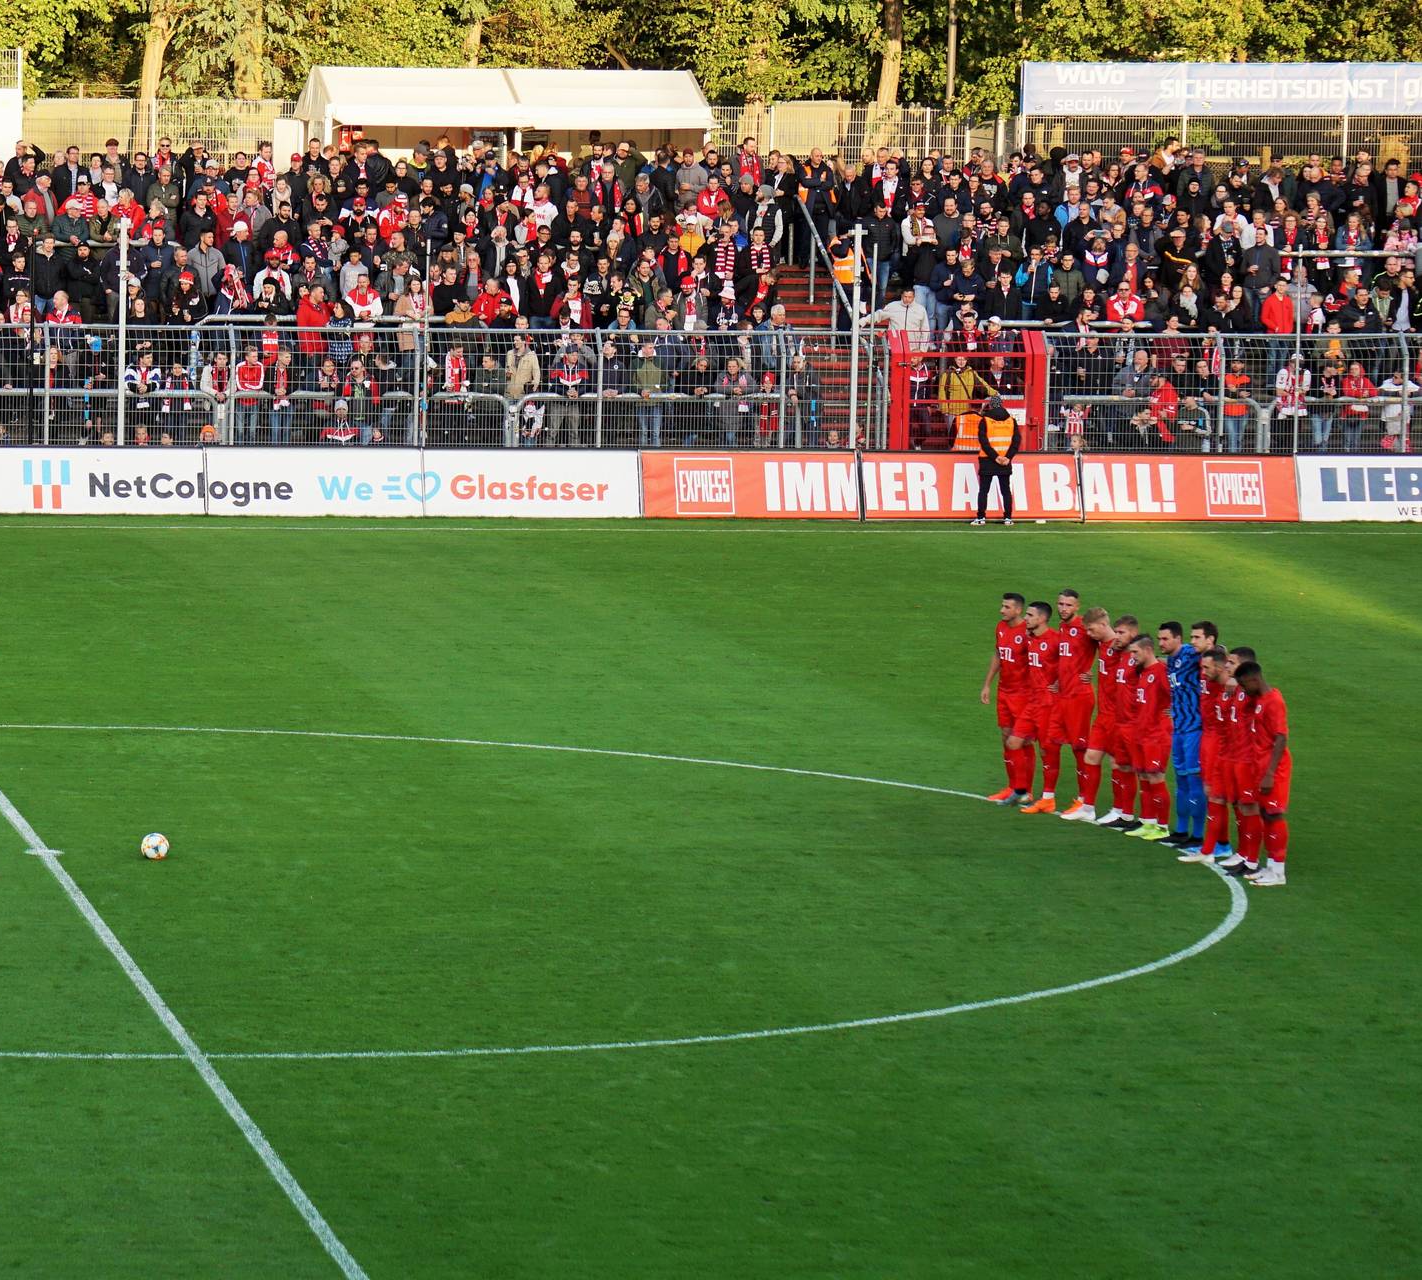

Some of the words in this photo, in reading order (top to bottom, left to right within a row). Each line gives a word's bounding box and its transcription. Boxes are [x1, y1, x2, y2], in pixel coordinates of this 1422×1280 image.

[1056, 66, 1126, 85] WuVo
[1159, 78, 1388, 99] SICHERHEITSDIENST
[1053, 95, 1124, 114] security
[89, 472, 294, 507] NetCologne
[318, 475, 373, 501] We
[450, 474, 609, 502] Glasfaser
[678, 469, 730, 503] EXPRESS
[764, 461, 940, 512] IMMER
[1038, 462, 1177, 514] BALL!
[1208, 472, 1261, 506] EXPRESS
[1320, 467, 1422, 502] LIEB
